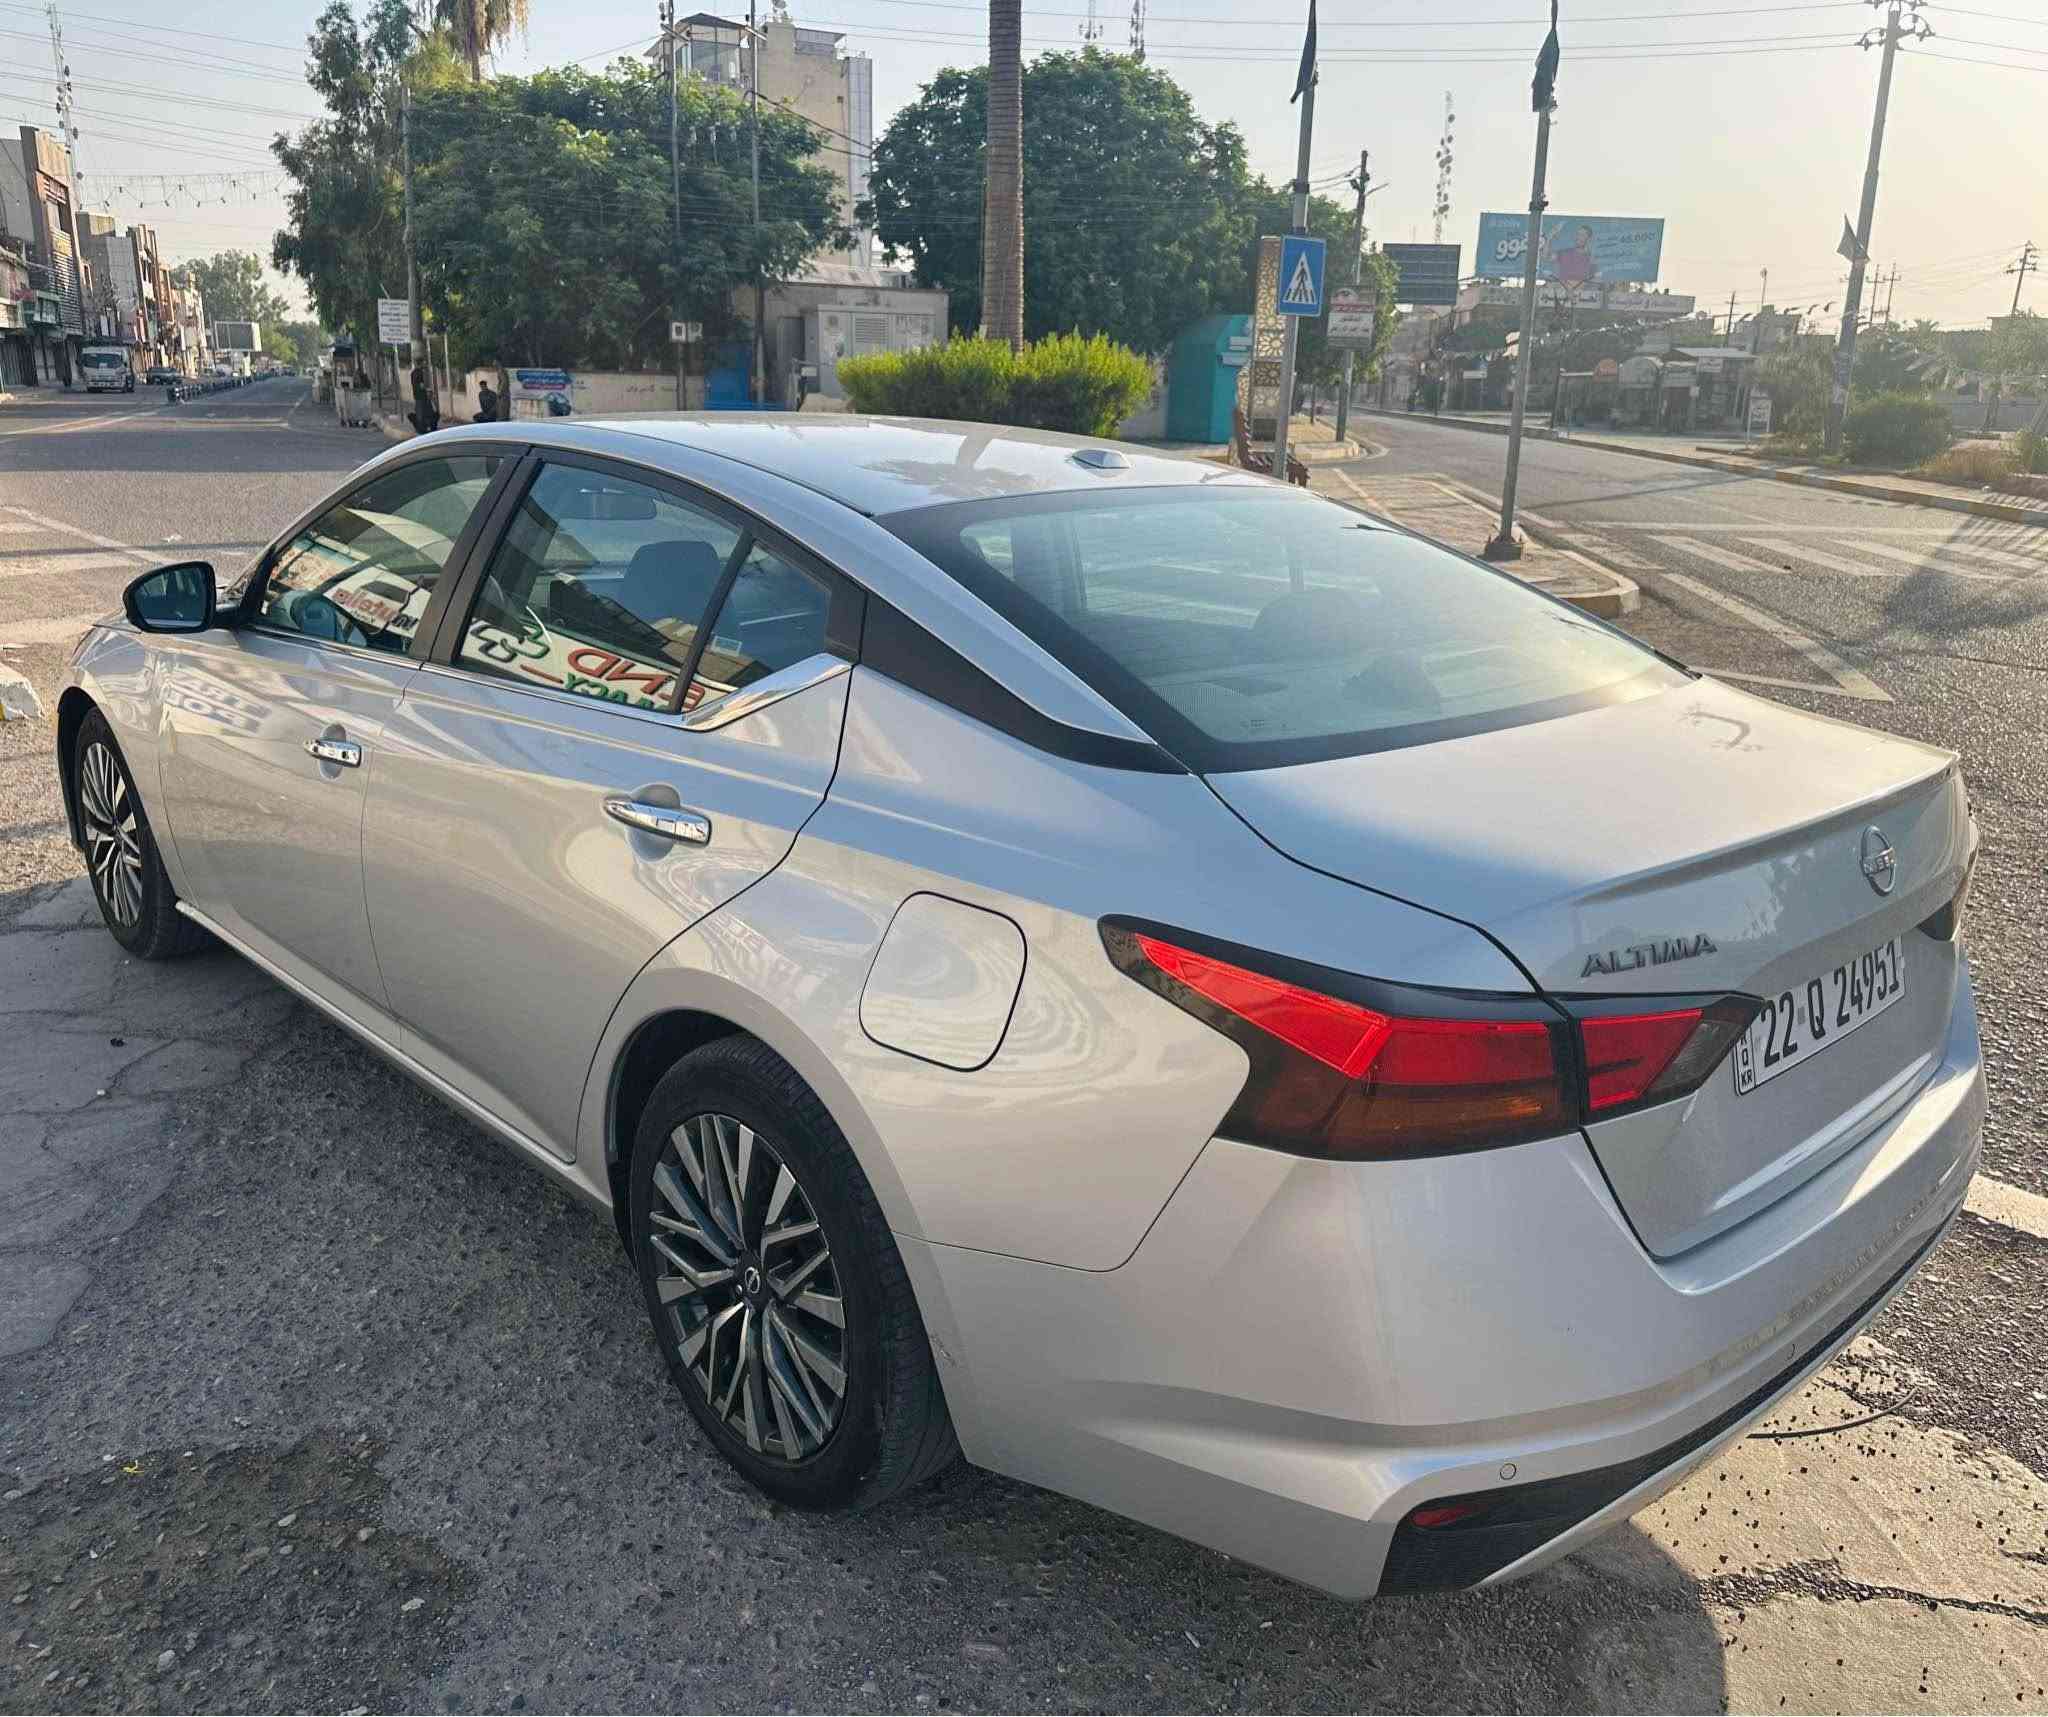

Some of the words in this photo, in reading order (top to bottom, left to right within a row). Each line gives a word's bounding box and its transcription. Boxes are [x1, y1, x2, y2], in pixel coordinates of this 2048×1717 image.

[1581, 932, 1719, 978] ALTIMA
[1761, 991, 1798, 1068] 22
[1807, 977, 1827, 1040] Q
[1833, 939, 1900, 1028] 24951
[1740, 1069, 1753, 1086] KR
